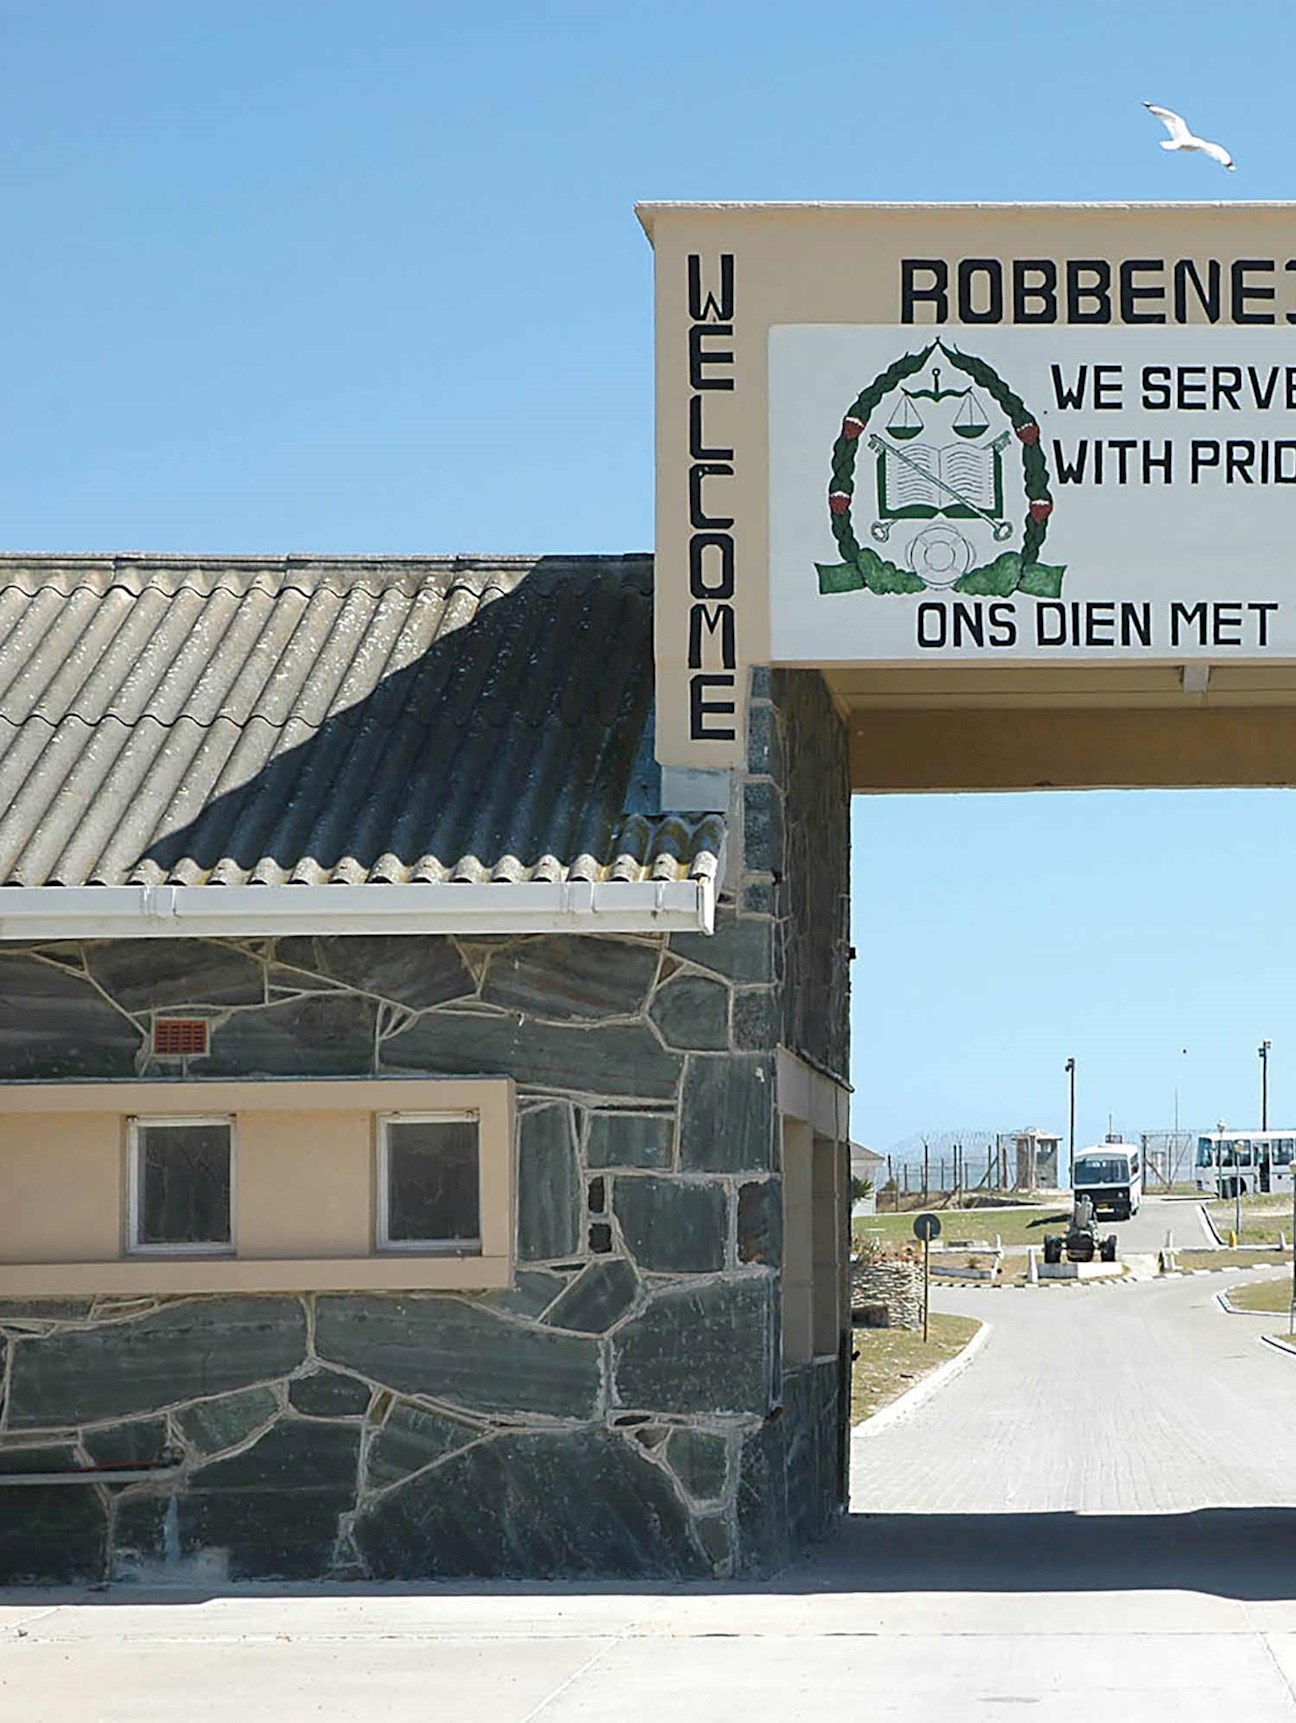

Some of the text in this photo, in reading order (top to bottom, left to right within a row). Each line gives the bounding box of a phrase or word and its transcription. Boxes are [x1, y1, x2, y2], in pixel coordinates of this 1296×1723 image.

[1052, 364, 1123, 410] WE
[1052, 439, 1172, 485] WITH
[687, 254, 735, 741] WELCOME
[917, 602, 1017, 648] ONS
[1036, 602, 1151, 647] DIEN
[1171, 602, 1279, 646] MET
